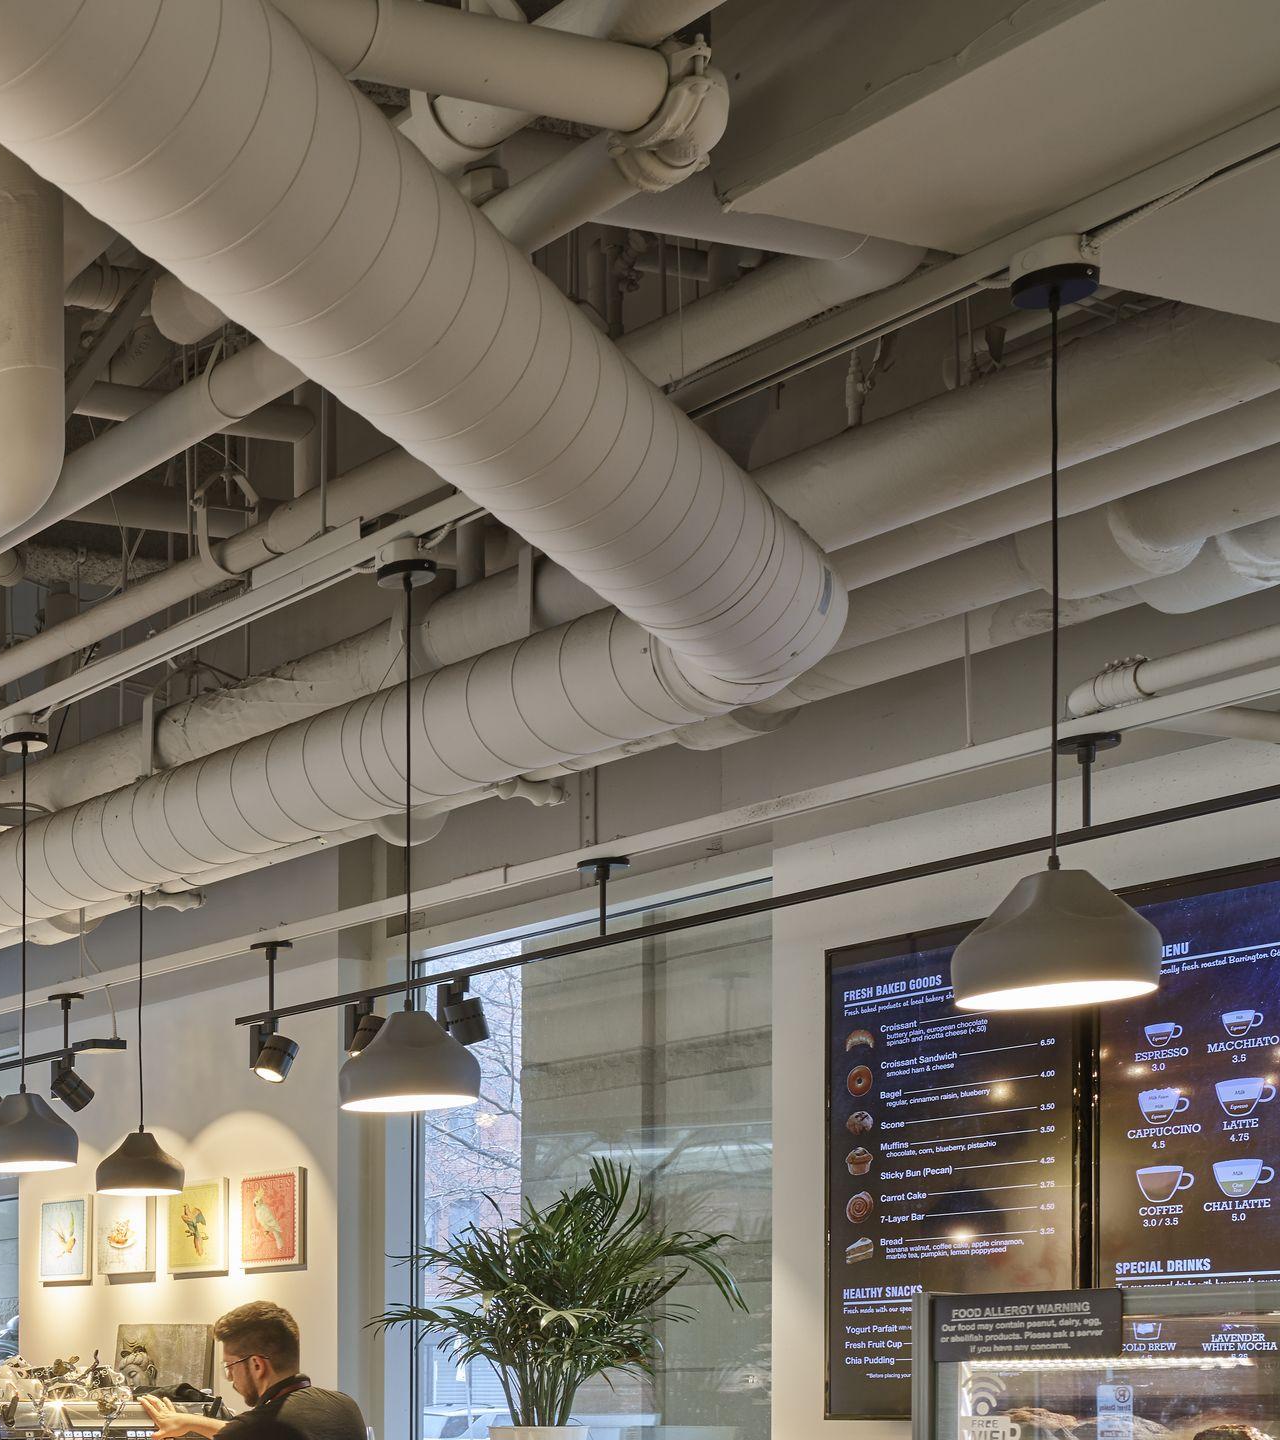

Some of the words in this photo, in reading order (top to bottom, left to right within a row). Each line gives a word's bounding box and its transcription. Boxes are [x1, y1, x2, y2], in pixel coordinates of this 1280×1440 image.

[1182, 962, 1199, 972] fresh
[1201, 957, 1228, 968] roasted
[1228, 952, 1269, 966] Barrington
[844, 986, 874, 1002] FRESH
[876, 980, 907, 997] BAKED
[909, 975, 942, 991] GOODS
[844, 1007, 861, 1017] Fresh
[861, 1004, 877, 1015] baked
[878, 1001, 902, 1013] products
[925, 993, 942, 1005] bakery
[880, 1020, 917, 1033] Croissant
[886, 1029, 908, 1041] buttery
[927, 1023, 956, 1035] european
[957, 1018, 988, 1030] chocolate
[886, 1036, 910, 1047] spinach
[924, 1031, 944, 1041] ricotta
[945, 1028, 968, 1038] cheese
[880, 1057, 917, 1070] Croissant
[919, 1051, 958, 1065] Sandwich
[1040, 1037, 1055, 1047] 6.50
[1134, 1046, 1189, 1062] ESPRESSO
[1207, 1035, 1280, 1054] MACCHIATO
[886, 1067, 910, 1078] smoked
[911, 1065, 925, 1075] ham
[932, 1061, 955, 1072] cheese
[1151, 1062, 1165, 1072] 3.0
[1232, 1053, 1246, 1063] 3.5
[880, 1089, 902, 1101] Bagel
[1040, 1069, 1055, 1079] 4.00
[910, 1094, 939, 1105] cinnamon
[960, 1087, 991, 1098] blueberry
[880, 1119, 905, 1130] Scone
[1040, 1102, 1055, 1111] 3.50
[1127, 1123, 1202, 1139] CAPPUCCINO
[1222, 1118, 1259, 1131] LATTE
[880, 1140, 909, 1151] Muffins
[1040, 1125, 1055, 1134] 3.50
[967, 1140, 997, 1151] pistachio
[1151, 1140, 1166, 1149] 4.5
[1229, 1132, 1250, 1142] 4.75
[880, 1169, 904, 1181] Sticky
[905, 1168, 921, 1178] Bun
[923, 1165, 953, 1178] (Pecan)
[1040, 1156, 1055, 1165] 4.25
[880, 1192, 905, 1203] Carrot
[906, 1190, 927, 1200] Cake
[1040, 1180, 1055, 1189] 3.75
[880, 1214, 910, 1224] 7-Layer
[911, 1212, 925, 1222] Bar
[1040, 1203, 1055, 1211] 4.50
[1139, 1204, 1183, 1217] COFFEE
[1203, 1199, 1233, 1212] CHAI
[1235, 1198, 1271, 1211] LATTE
[1143, 1218, 1156, 1228] 3.0
[1165, 1217, 1179, 1226] 3.5
[1231, 1212, 1246, 1222] 5.0
[880, 1237, 903, 1246] Bread
[1040, 1226, 1055, 1235] 3.25
[886, 1245, 908, 1254] banana
[971, 1240, 990, 1249] apple
[886, 1252, 906, 1261] marble
[950, 1247, 969, 1256] lemon
[970, 1245, 1007, 1257] poppyseed
[1115, 1260, 1163, 1275] SPECIAL
[1167, 1258, 1211, 1273] DRINKS
[843, 1287, 883, 1299] HEALTHY
[885, 1285, 923, 1297] SNACKS
[951, 1308, 981, 1319] FOOD
[984, 1304, 1035, 1317] ALLERGY
[1037, 1301, 1090, 1314] WARNING
[845, 1325, 871, 1335] Yogurt
[872, 1324, 898, 1333] Parfait
[941, 1323, 957, 1332] Our
[958, 1321, 975, 1331] food
[977, 1322, 993, 1331] may
[995, 1320, 1025, 1329] contain
[1027, 1320, 1057, 1330] peanut,
[985, 1332, 1022, 1342] products.
[1024, 1330, 1051, 1339] Please
[1053, 1330, 1068, 1338] ask
[1077, 1328, 1104, 1337] server
[1211, 1333, 1265, 1343] LAVENDER
[845, 1341, 866, 1349] Fresh
[868, 1340, 885, 1348] Fruit
[886, 1339, 903, 1349] Cup
[977, 1345, 991, 1353] you
[993, 1344, 1013, 1352] have
[1014, 1344, 1029, 1352] any
[1030, 1342, 1071, 1351] concerns.
[1149, 1342, 1177, 1351] BREW
[1202, 1342, 1234, 1351] WHITE
[1237, 1341, 1278, 1351] MOCHA
[845, 1356, 862, 1365] Chia
[864, 1355, 895, 1365] Pudding
[972, 1420, 999, 1428] FREE
